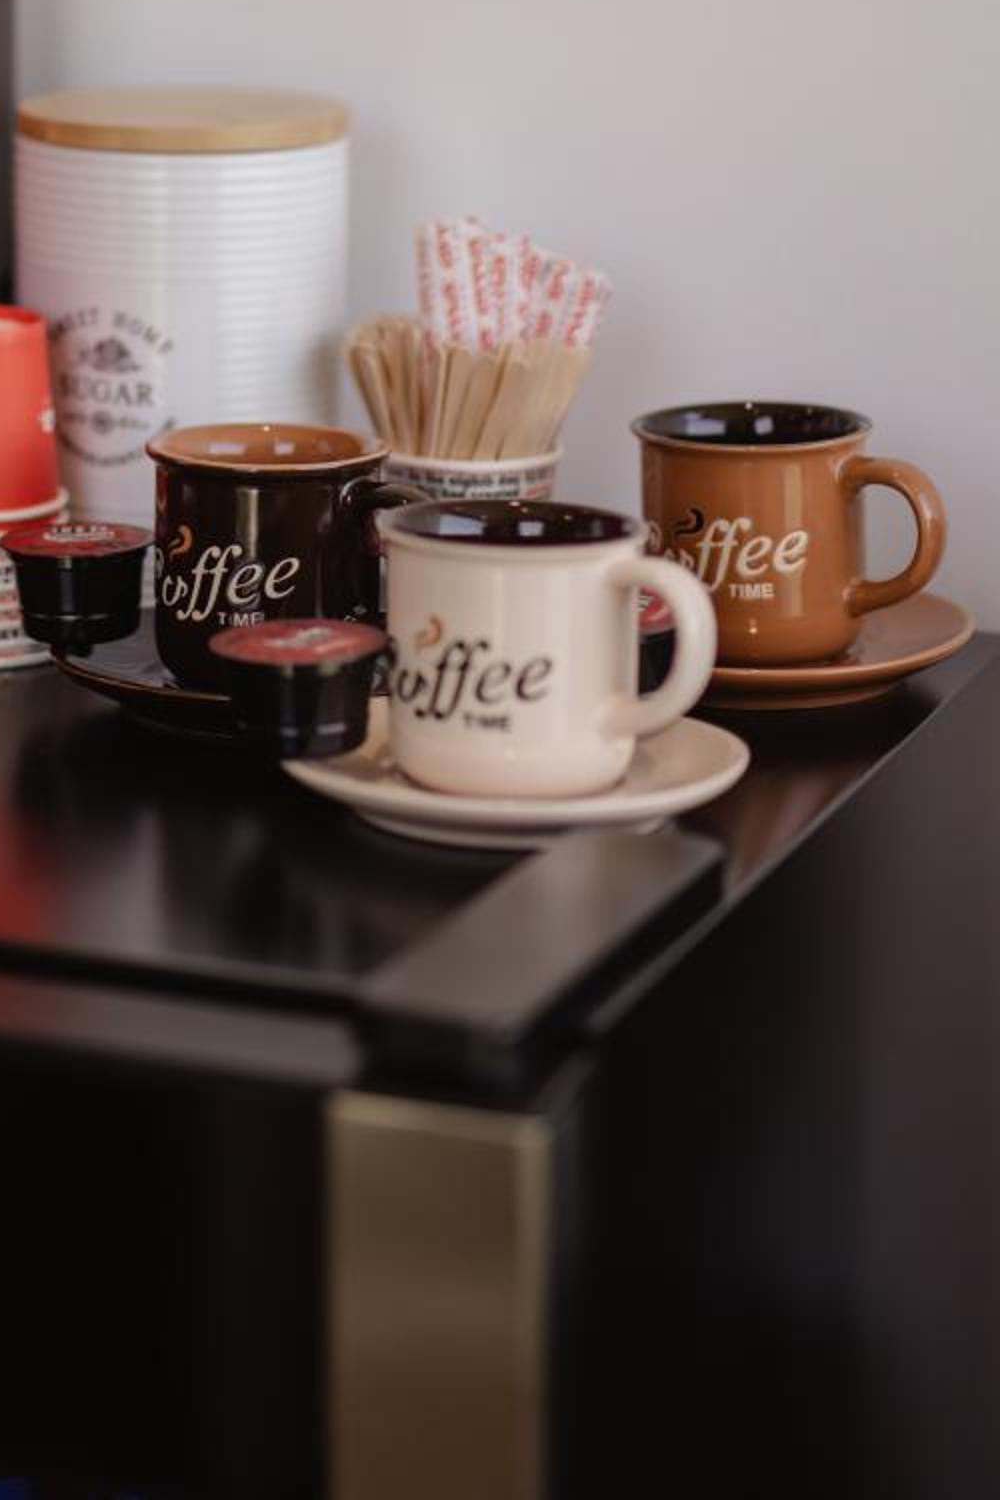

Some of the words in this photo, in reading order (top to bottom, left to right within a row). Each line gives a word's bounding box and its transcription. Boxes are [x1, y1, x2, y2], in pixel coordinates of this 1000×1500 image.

[58, 373, 155, 408] SUGAR
[648, 517, 809, 592] ffee
[728, 583, 775, 598] TIME
[388, 638, 552, 720] offee
